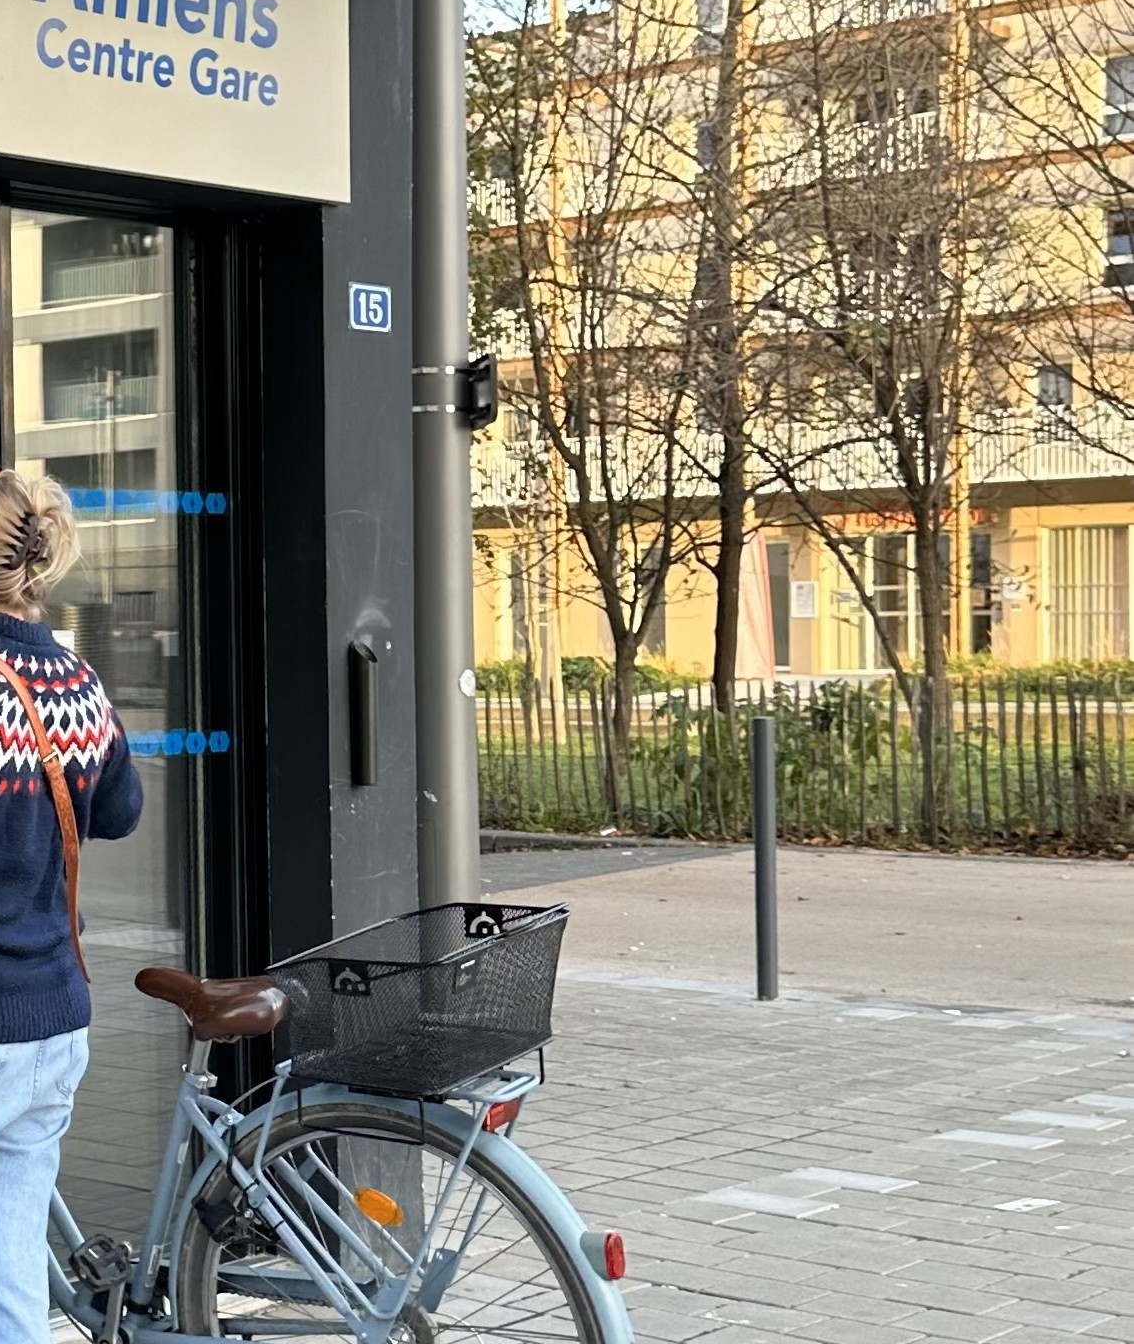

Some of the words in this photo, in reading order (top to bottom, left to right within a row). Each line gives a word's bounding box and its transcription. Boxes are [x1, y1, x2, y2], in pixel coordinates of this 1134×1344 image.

[36, 17, 175, 88] Centre
[189, 47, 279, 107] Gare
[358, 291, 384, 325] 15
